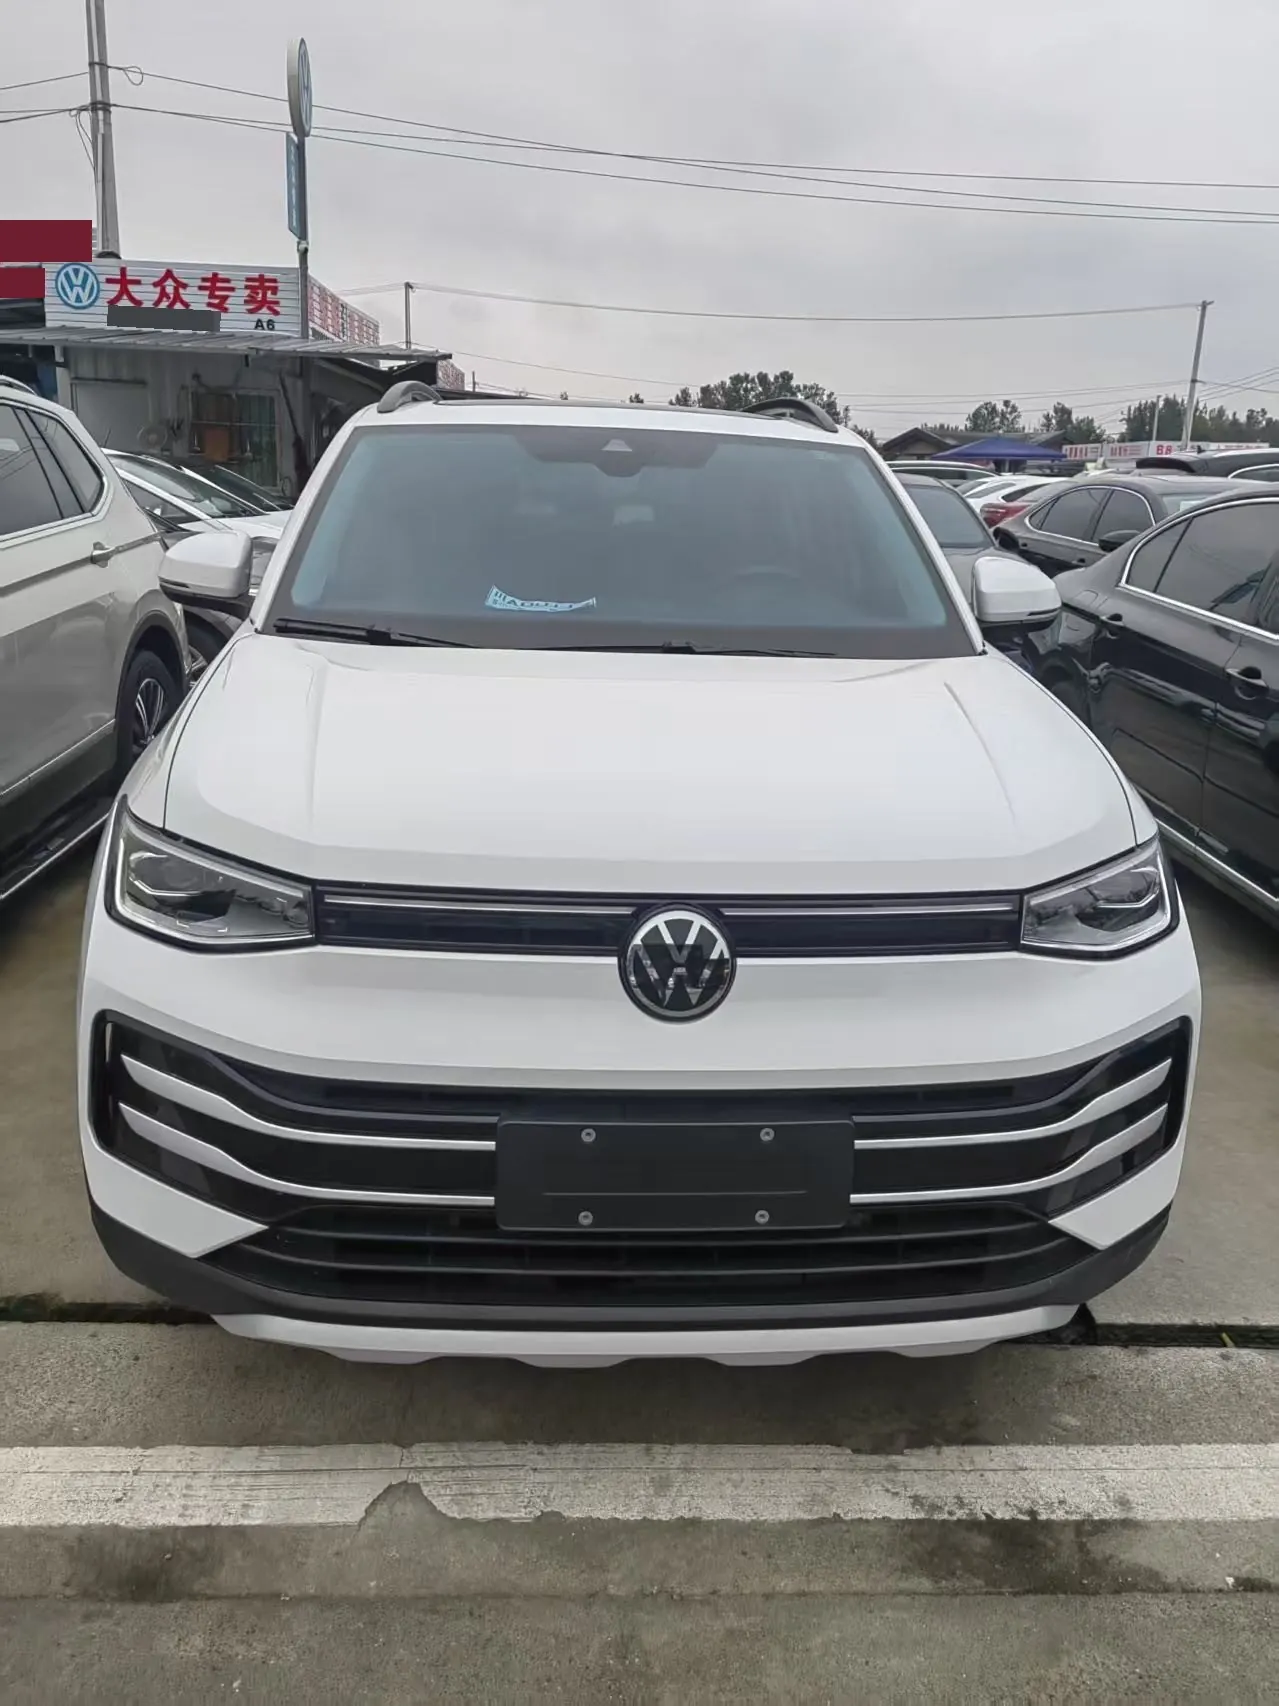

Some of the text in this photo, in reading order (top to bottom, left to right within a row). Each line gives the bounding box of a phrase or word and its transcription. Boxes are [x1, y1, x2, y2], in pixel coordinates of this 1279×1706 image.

[105, 266, 281, 316] 大众专卖
[254, 318, 276, 331] A6
[627, 908, 732, 1018] VW
